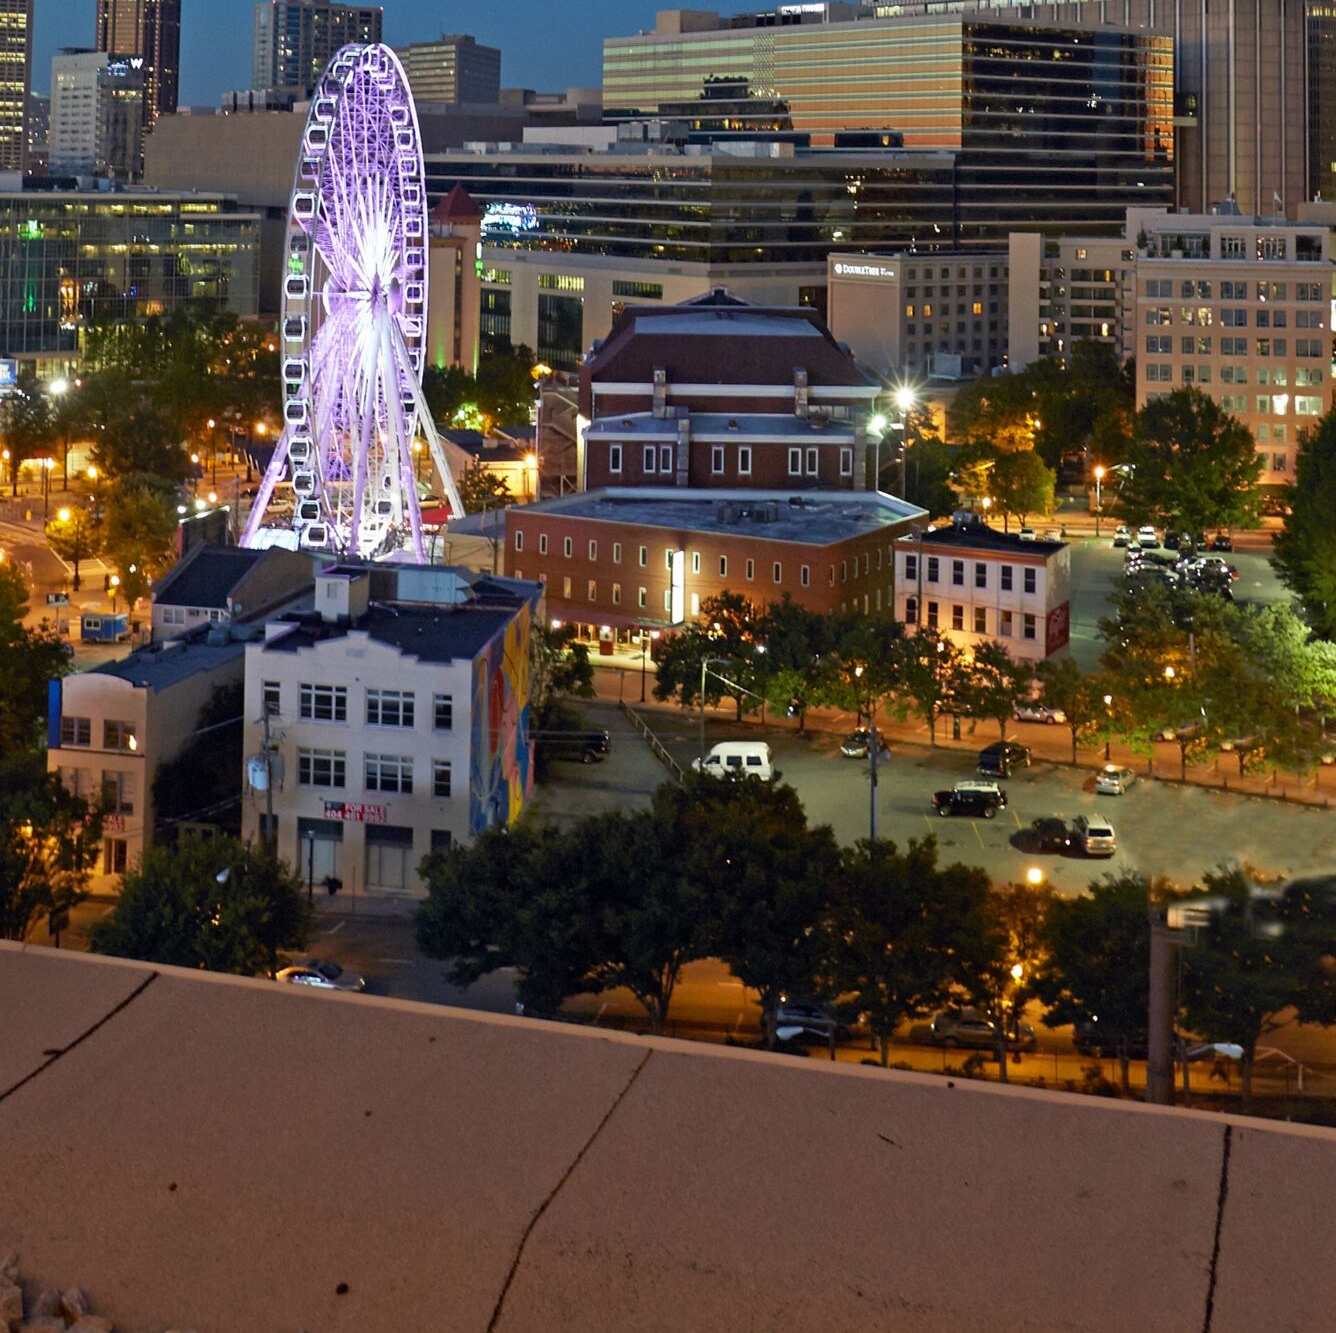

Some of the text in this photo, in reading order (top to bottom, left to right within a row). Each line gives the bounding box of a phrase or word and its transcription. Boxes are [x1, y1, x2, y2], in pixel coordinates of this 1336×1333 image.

[130, 57, 143, 69] W
[345, 802, 385, 815] FOR SALE
